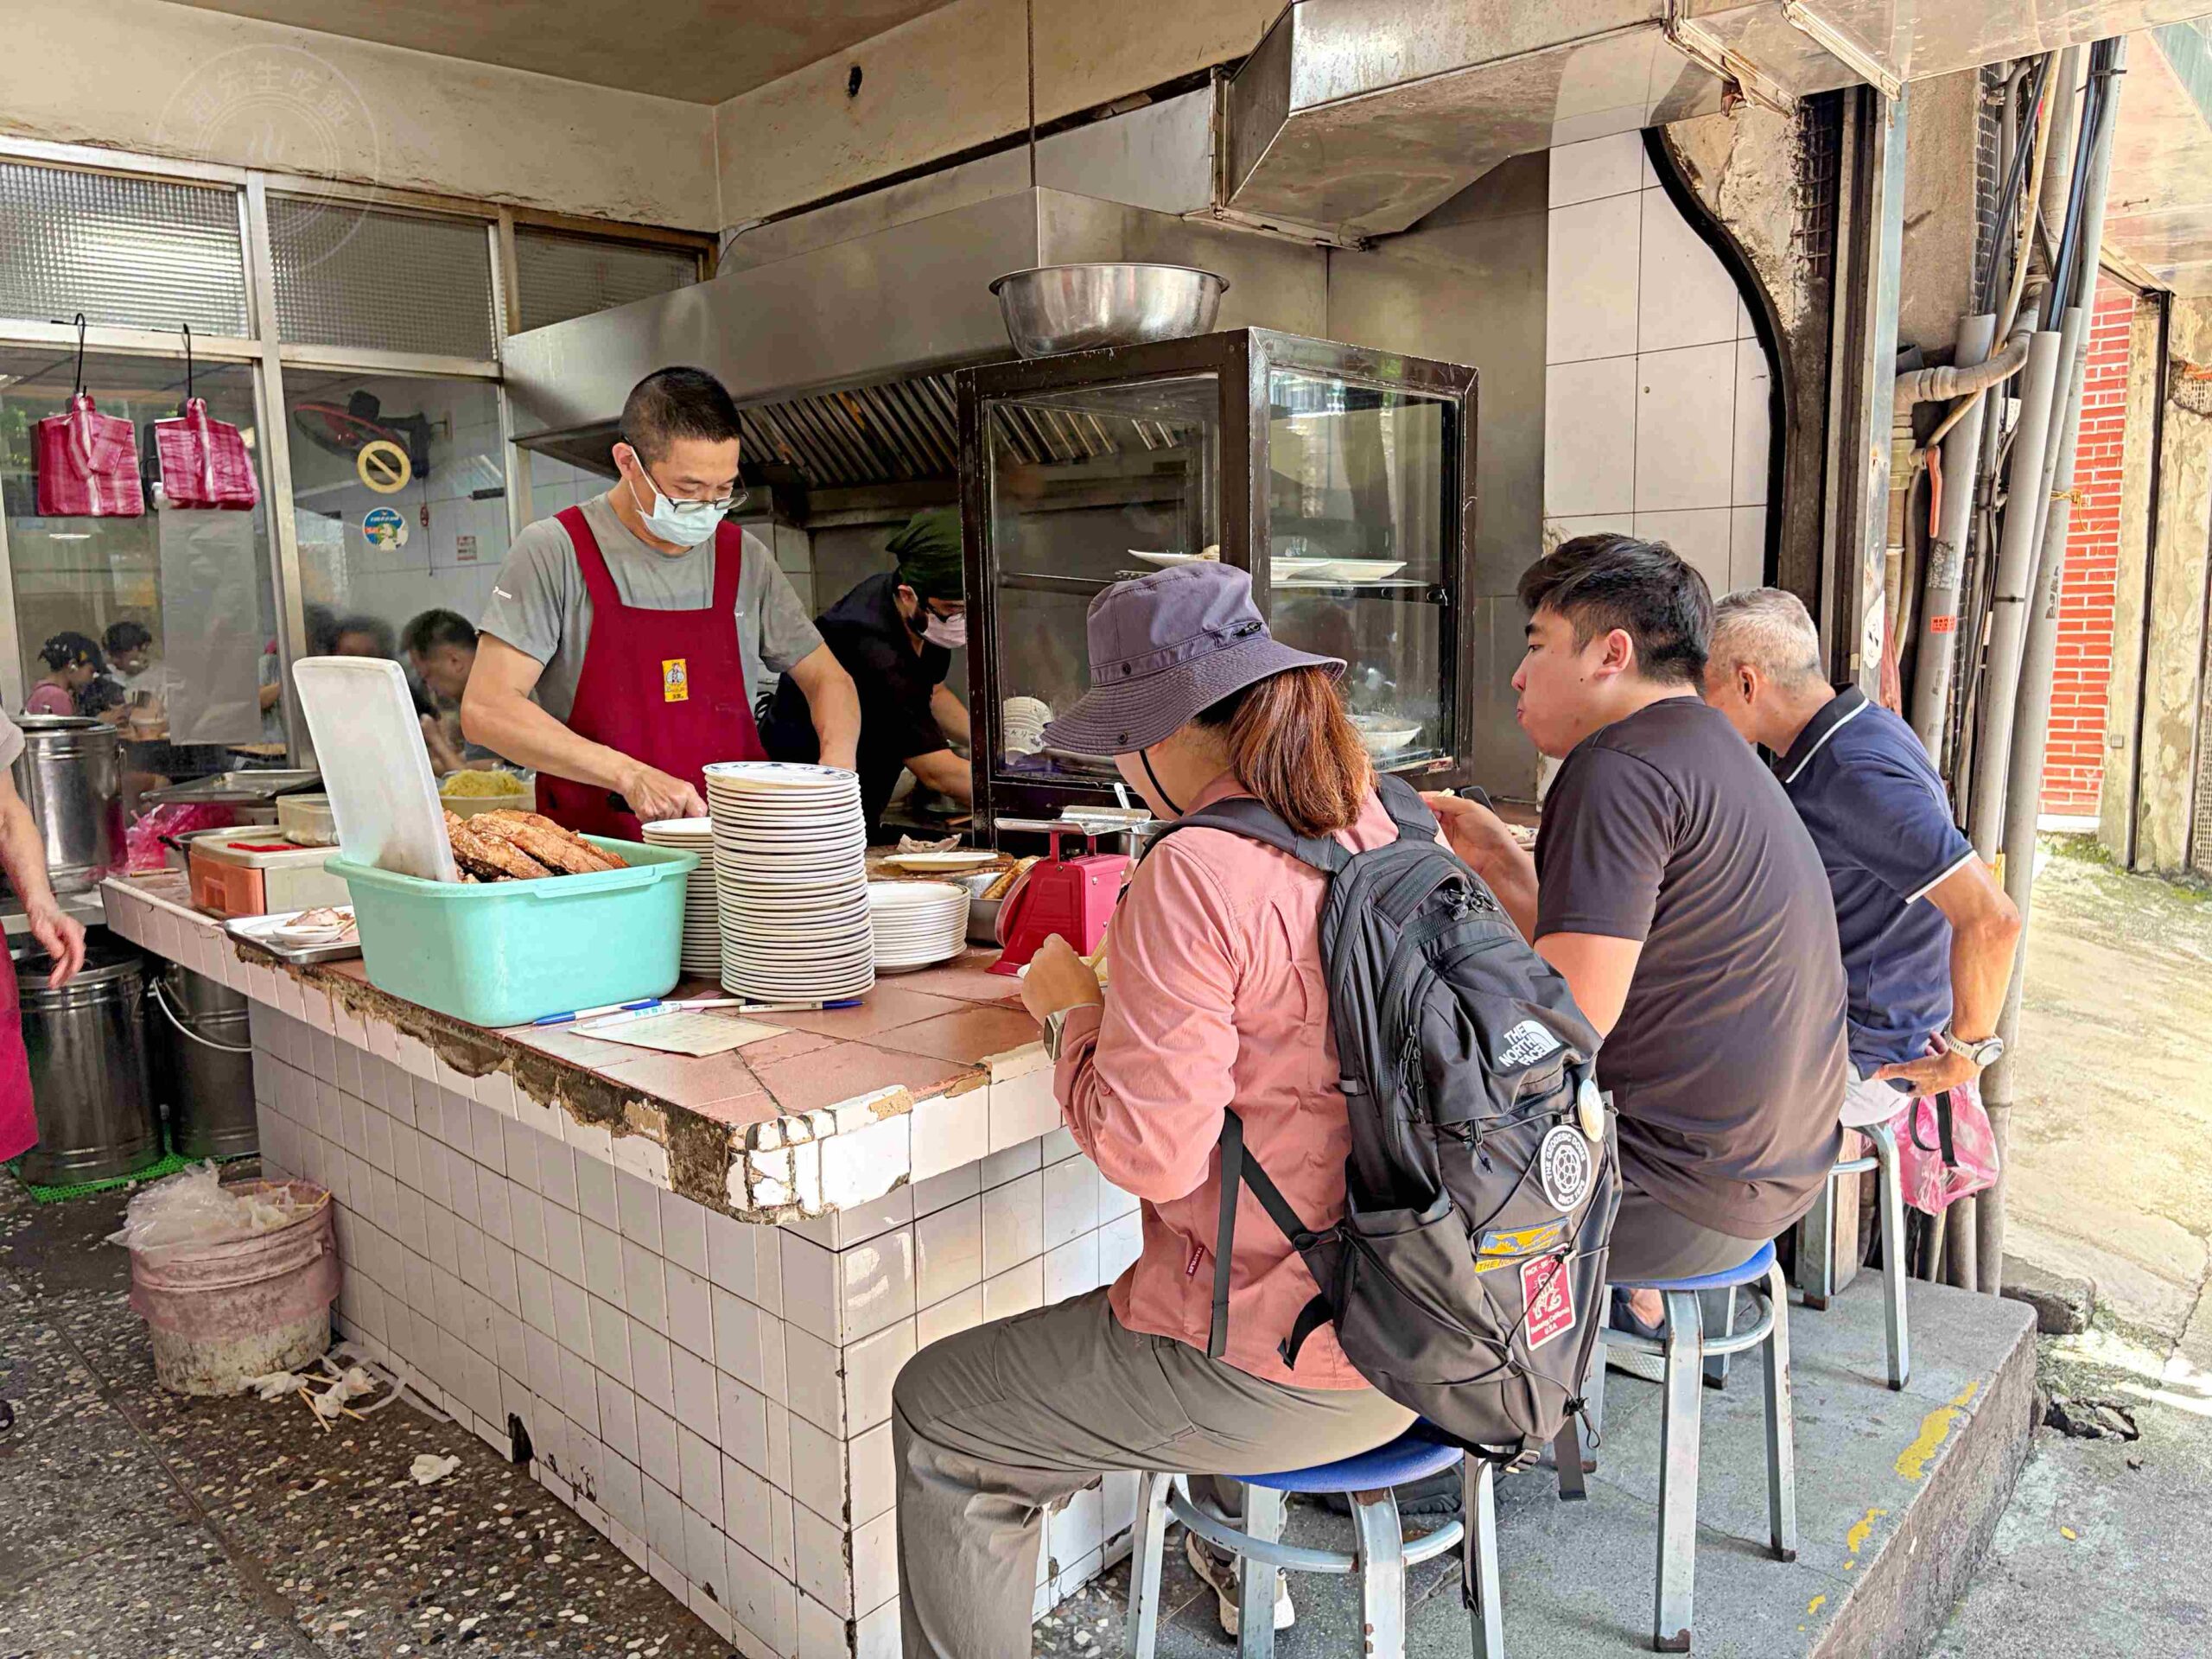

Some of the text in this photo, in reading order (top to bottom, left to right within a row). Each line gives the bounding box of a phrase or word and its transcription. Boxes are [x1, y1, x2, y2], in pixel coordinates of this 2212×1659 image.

[1503, 1023, 1527, 1046] THE
[1498, 1034, 1536, 1067] NORTH
[1518, 1045, 1545, 1065] FACE
[1547, 1132, 1572, 1159] GEODESIC
[1572, 1136, 1586, 1162] DOME
[1478, 1260, 1499, 1272] THE
